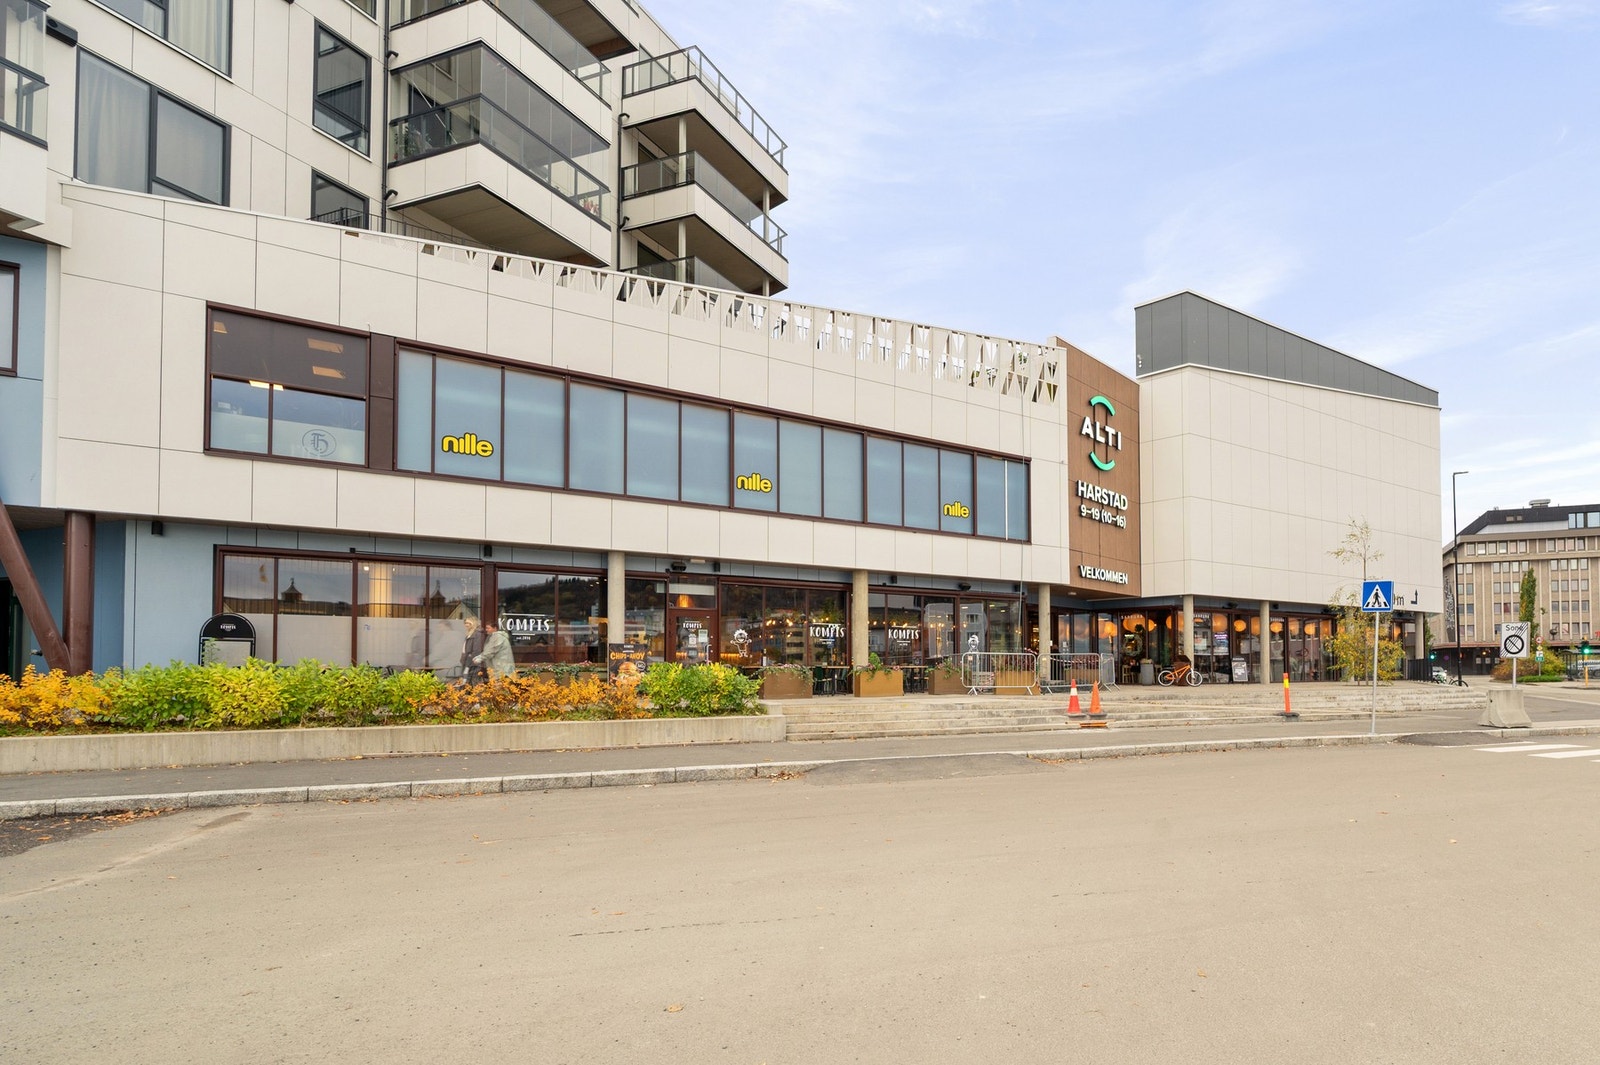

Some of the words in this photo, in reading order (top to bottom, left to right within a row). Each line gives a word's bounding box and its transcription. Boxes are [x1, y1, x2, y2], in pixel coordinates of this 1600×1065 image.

[1081, 416, 1122, 451] ALTI
[441, 431, 494, 458] nille
[736, 472, 772, 494] nille
[1077, 480, 1128, 511] HARSTAD
[943, 500, 970, 519] nille
[1080, 565, 1129, 584] VELKOMMEN
[498, 617, 551, 632] KOMPIS
[809, 626, 845, 638] KOMPIS
[888, 628, 920, 640] KOMPIS
